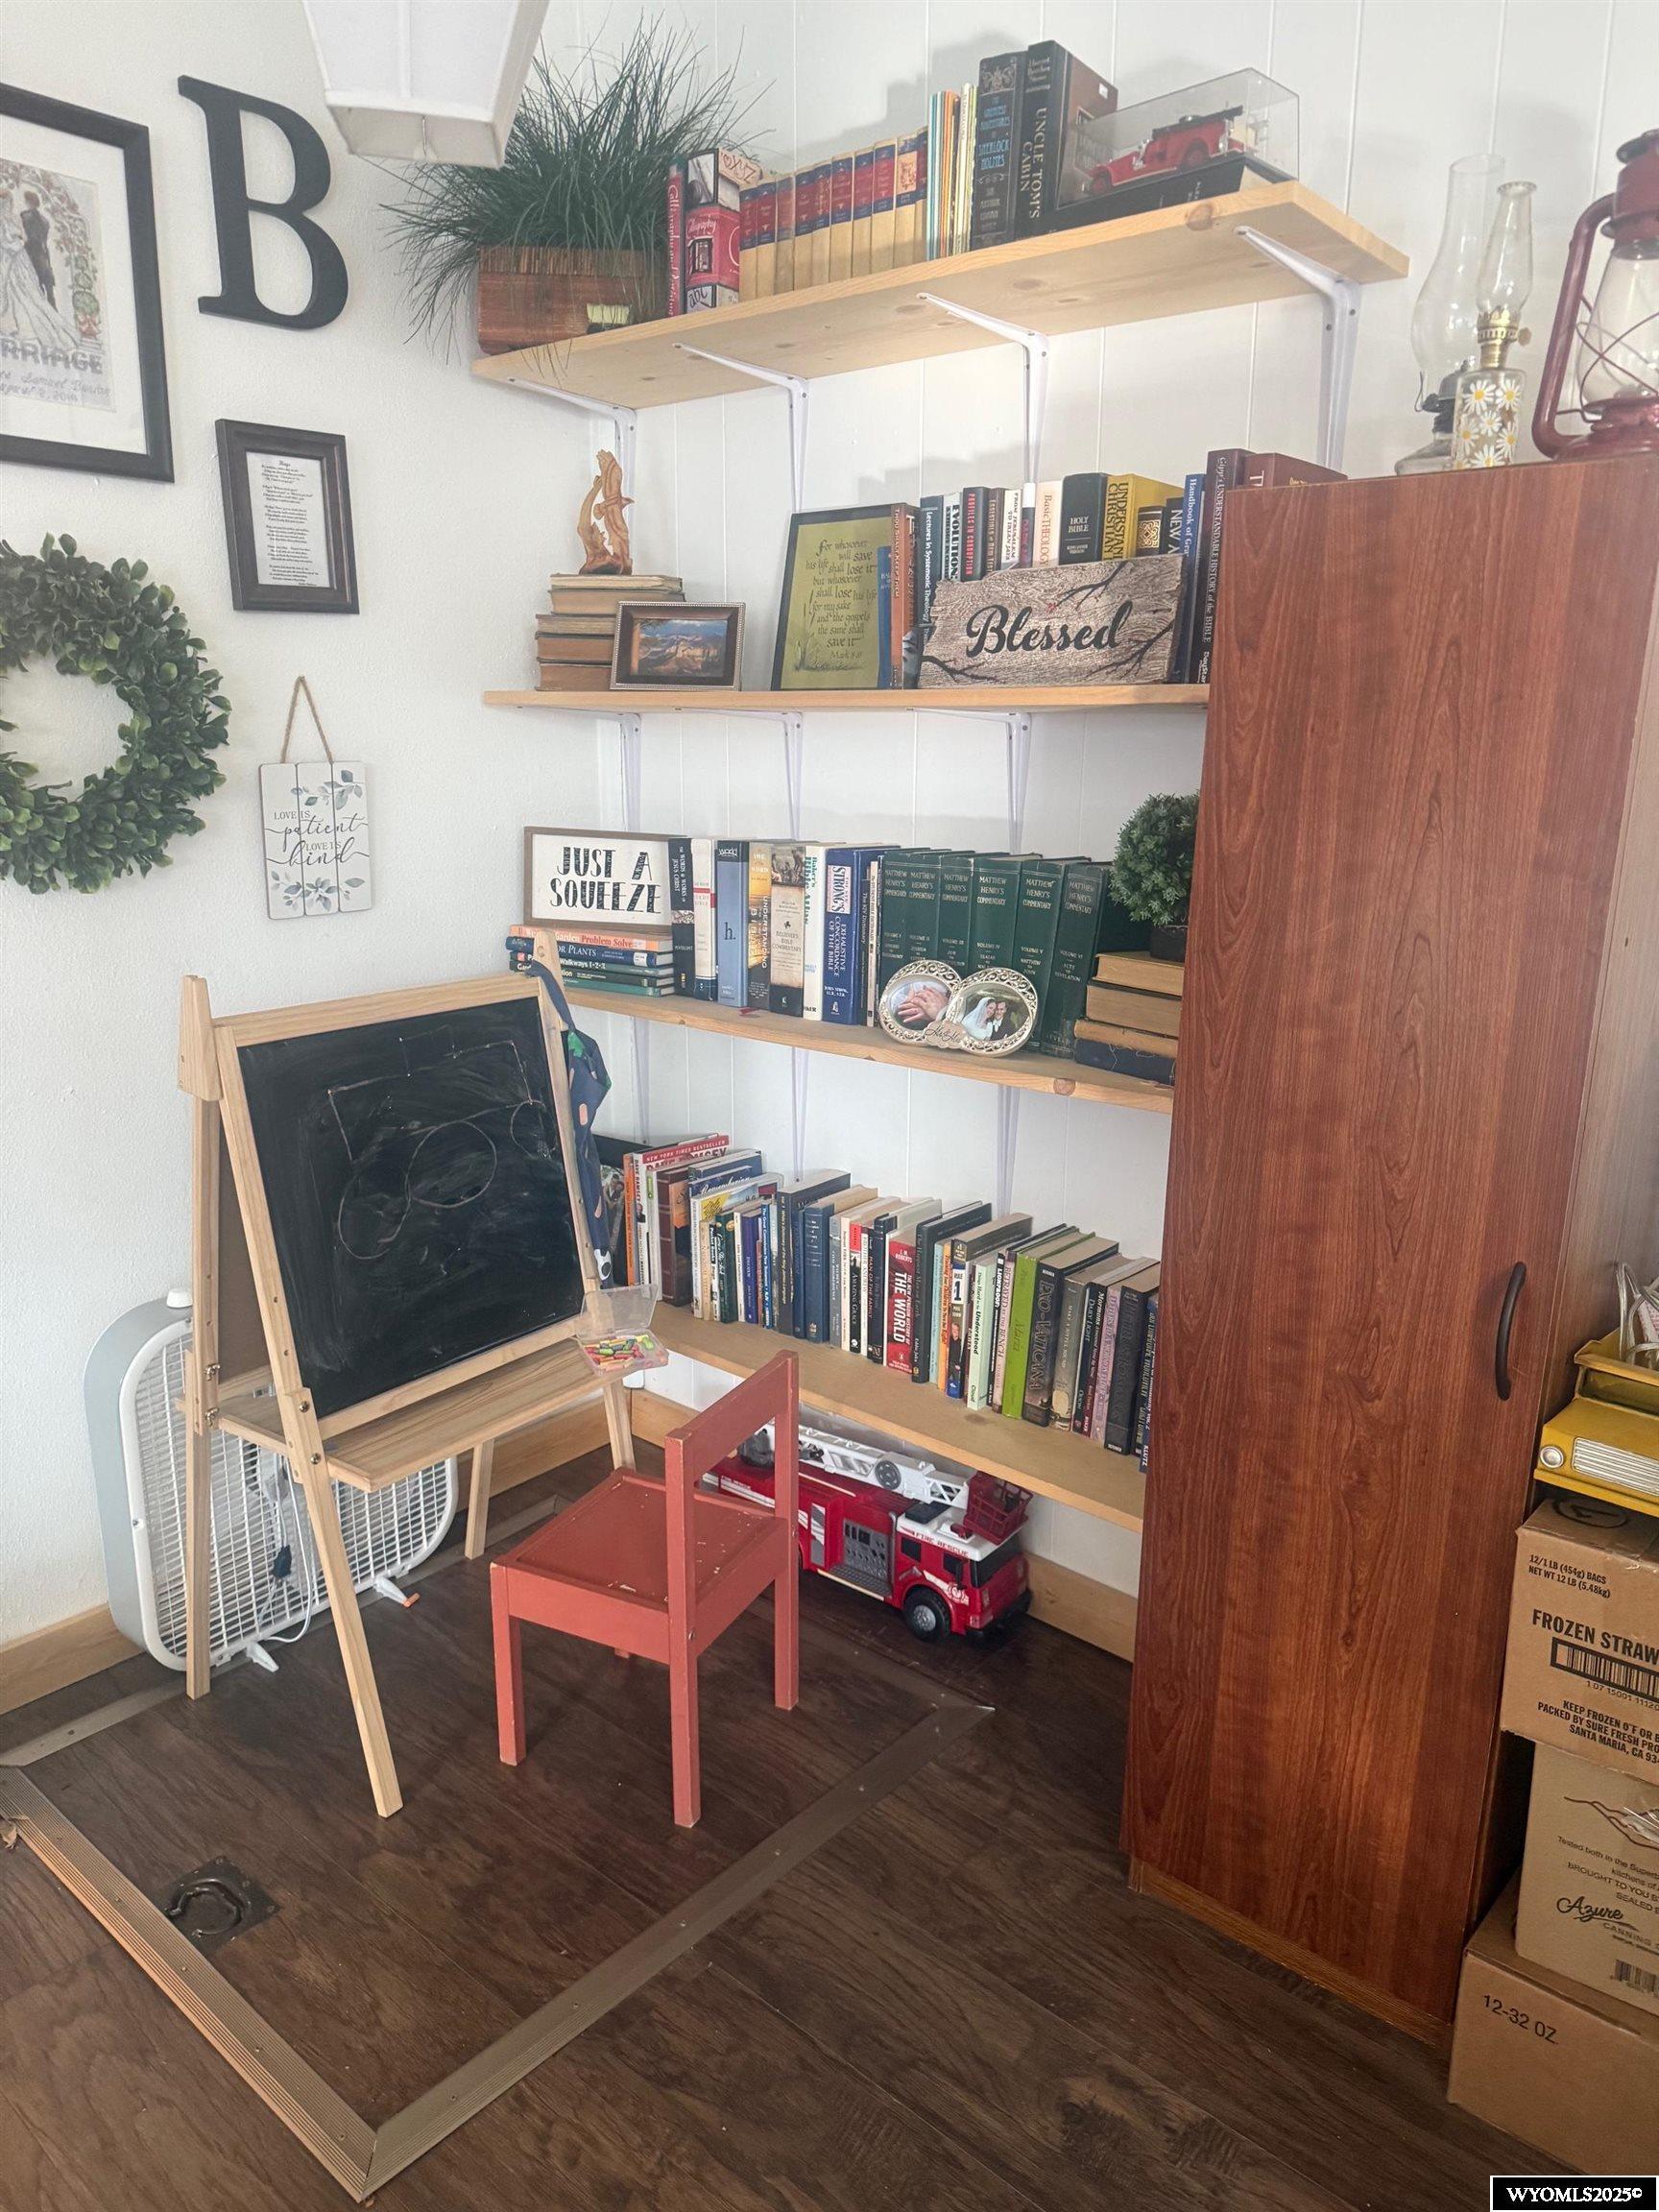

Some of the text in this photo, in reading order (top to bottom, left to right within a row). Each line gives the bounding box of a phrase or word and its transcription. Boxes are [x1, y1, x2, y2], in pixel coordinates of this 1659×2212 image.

[981, 155, 1005, 170] HOLMES
[1019, 141, 1033, 192] CABIN
[1029, 108, 1047, 219] UNCLE TOM'S
[178, 75, 349, 329] B
[1070, 517, 1089, 525] HOLY
[1104, 483, 1118, 553] CHRISTIAN
[1186, 479, 1197, 536] Handbook of
[1040, 494, 1052, 566] Basic THEOLOGY
[1068, 524, 1089, 533] BIBLE
[1169, 510, 1183, 538] NEW
[853, 552, 873, 562] save
[966, 536, 974, 575] CORRUPTION
[1204, 457, 1227, 642] Gipp's UNDERSTANDABLE HISTORY of the BIBLE
[847, 563, 863, 575] lose
[924, 551, 932, 588] Systematic
[835, 589, 852, 598] lose
[923, 589, 931, 622] Theology
[966, 599, 1133, 658] Blessed
[1200, 651, 1210, 684] DayStar
[274, 811, 296, 820] LOVE
[272, 813, 365, 853] patient
[305, 841, 327, 852] LOVE
[273, 837, 364, 867] kind
[557, 846, 653, 881] JUST A
[831, 868, 846, 912] STRONG'S
[944, 874, 969, 882] MATTHEW
[980, 877, 1006, 885] MATTHEW
[981, 886, 1004, 896] HENRY'S
[1026, 878, 1052, 887] MATTHEW
[1070, 882, 1094, 892] MATTHEW
[549, 878, 661, 914] SQUEEZE
[977, 897, 1006, 905] COMMENTARY
[1023, 900, 1051, 909] COMMENTARY
[1027, 889, 1050, 899] HENRY'S
[1065, 902, 1092, 914] COMMENTARY
[1069, 892, 1092, 902] HENRY'S
[776, 929, 798, 939] BELIEVER'S
[829, 921, 835, 931] OF
[568, 945, 597, 957] PLANTS
[581, 935, 612, 947] Problem
[772, 943, 802, 952] COMMENTARY
[660, 1151, 673, 1160] YORK
[675, 1147, 691, 1156] TIMES
[693, 1140, 726, 1152] BESTSELLER
[868, 1273, 874, 1284] OF
[953, 1281, 962, 1301] 1
[893, 1272, 906, 1343] THE WORLD
[997, 1267, 1012, 1358] BETRAYED BENCH
[1087, 1298, 1095, 1319] DAILY
[1095, 1291, 1105, 1326] Mormons
[1106, 1296, 1116, 1325] LETTERS
[973, 1311, 981, 1355] Understood
[1028, 1281, 1055, 1390] EXO-VATICANA
[1100, 1342, 1111, 1372] MORMON
[1528, 1565, 1611, 1599] NET WT 12 LB (5.48kg)
[1529, 1554, 1607, 1584] 12/1 LB (454g) BAGS
[1532, 1608, 1659, 1666] FROZEN STRAW
[1607, 1687, 1632, 1701] 15001
[1537, 1701, 1640, 1745] PACKED BY SURE FRESH
[1563, 1699, 1652, 1740] KEEP FROZEN OR
[1569, 1724, 1644, 1760] SANTA MARIA, CA
[1557, 1835, 1628, 1869] Tested both in the
[1568, 1861, 1649, 1899] BROUGHT TO YOU
[1611, 1868, 1658, 1890] kitchens of
[1556, 1896, 1623, 1922] Azure
[1616, 1891, 1653, 1912] SEALED
[1603, 1921, 1652, 1947] CANNING
[1482, 1993, 1559, 2045] 12-32 OZ
